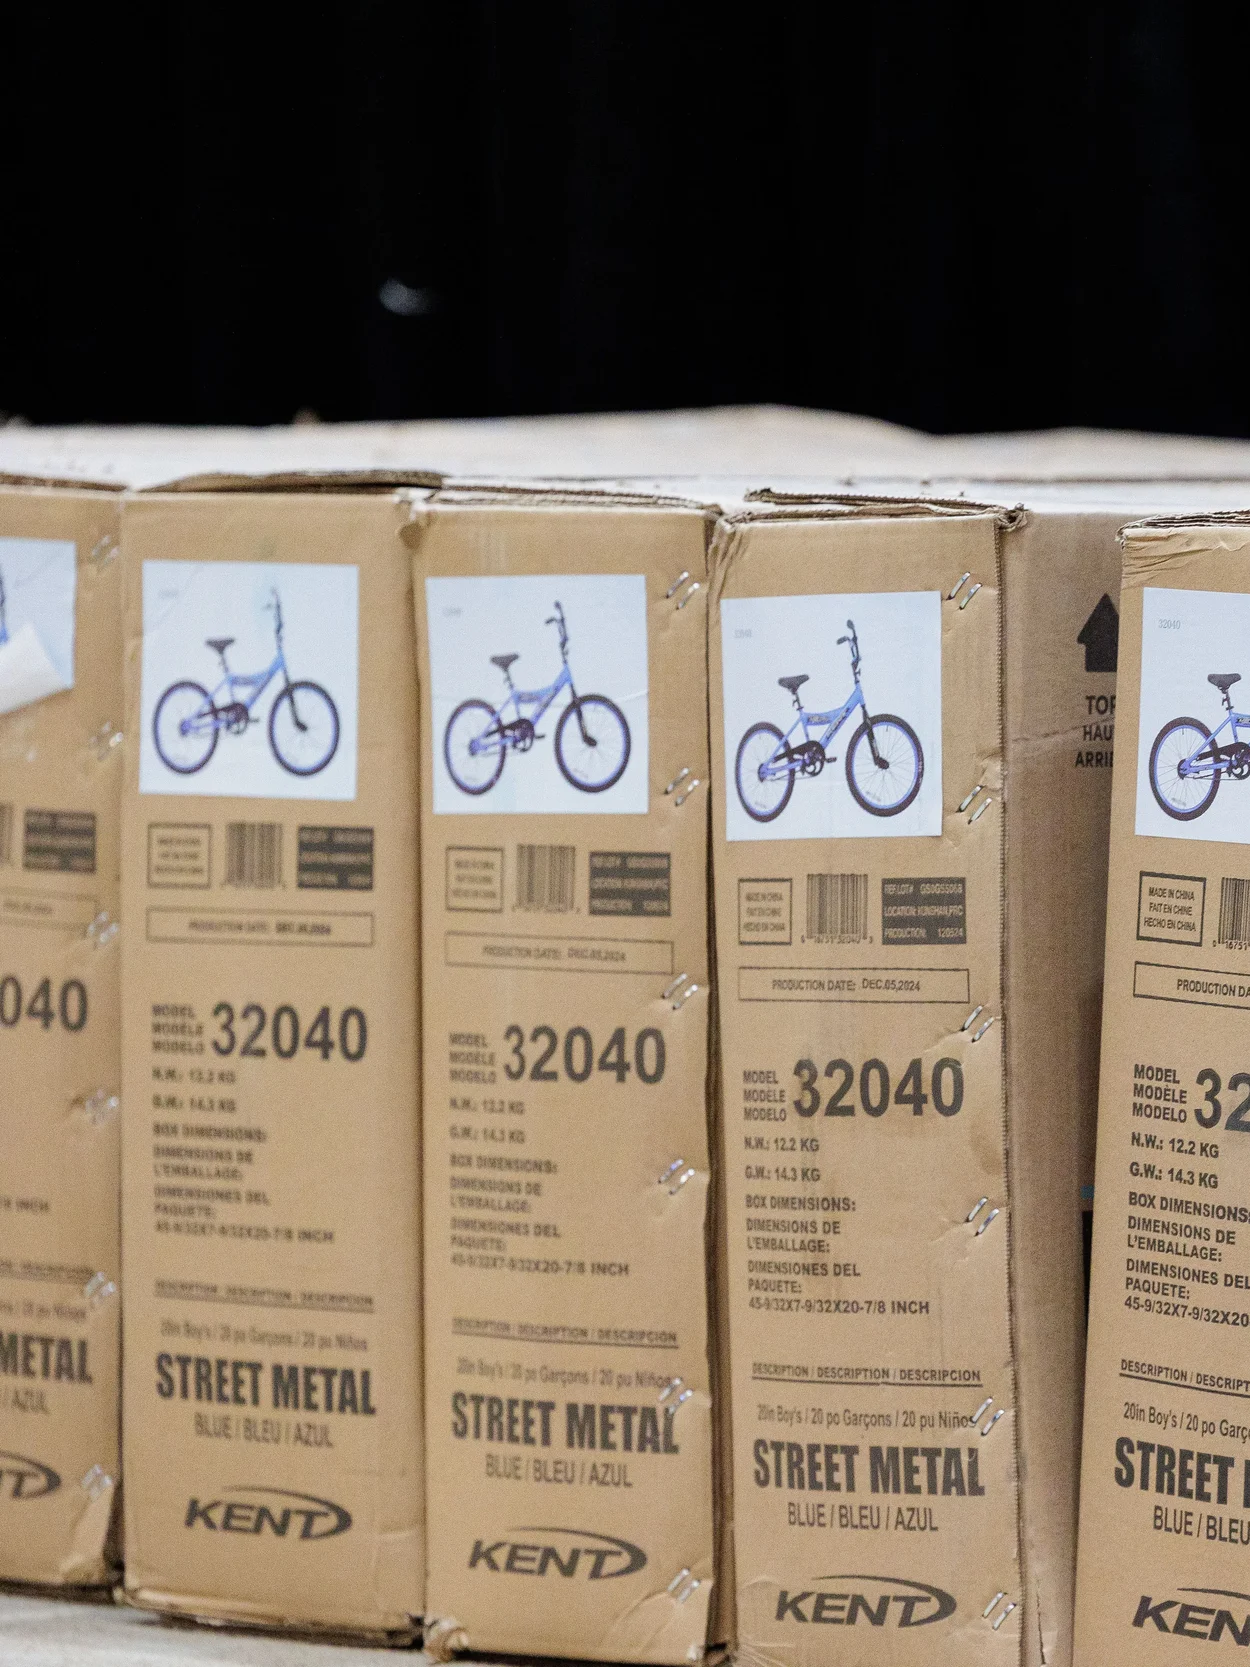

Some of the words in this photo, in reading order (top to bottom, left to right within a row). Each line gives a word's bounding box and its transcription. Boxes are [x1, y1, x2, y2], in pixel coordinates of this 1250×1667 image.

[1158, 618, 1181, 630] 32040
[1082, 725, 1115, 741] HAU
[1149, 887, 1167, 898] MADE
[1168, 889, 1174, 899] IN
[1175, 890, 1195, 901] CHINA
[1149, 902, 1164, 913] FAIT
[1164, 903, 1173, 914] EN
[1174, 905, 1192, 916] CHINE
[1144, 917, 1166, 928] HECHO
[1168, 919, 1176, 930] EN
[1177, 920, 1196, 932] CHINA
[772, 979, 825, 991] PRODUCTION
[1177, 978, 1236, 997] PRODUCTION
[212, 1001, 368, 1063] 32040
[504, 1024, 666, 1084] 32040
[743, 1070, 779, 1085] MODEL
[793, 1057, 964, 1118] 32040
[1134, 1064, 1180, 1084] MODEL
[1133, 1084, 1187, 1104] MODÈLE
[1132, 1102, 1187, 1123] MODELO
[1131, 1132, 1163, 1150] N.W.:
[1169, 1138, 1196, 1155] 12.2
[1200, 1143, 1219, 1158] KG
[1130, 1162, 1162, 1180] G.W.:
[1168, 1168, 1194, 1185] 14.3
[1199, 1173, 1218, 1189] KG
[1129, 1191, 1156, 1209] BOX
[1128, 1216, 1210, 1241] DIMENSIONS
[1216, 1230, 1236, 1245] DE
[1128, 1234, 1222, 1262] L'EMBALLAGE:
[1126, 1258, 1218, 1285] DIMENSIONES
[1126, 1278, 1190, 1300] PAQUETE:
[891, 1301, 929, 1314] INCH
[0, 1330, 93, 1385] METAL
[1121, 1359, 1187, 1382] DESCRIPTION
[156, 1351, 263, 1407] STREET
[272, 1363, 376, 1417] METAL
[452, 1391, 555, 1447] STREET
[566, 1402, 680, 1454] METAL
[1123, 1402, 1146, 1422] 20in
[1149, 1407, 1177, 1430] Boy's
[1186, 1413, 1199, 1432] 20
[1202, 1418, 1215, 1437] po
[486, 1453, 522, 1480] BLUE
[534, 1459, 575, 1485] BLEU
[588, 1462, 633, 1488] AZUL
[753, 1438, 859, 1493] STREET
[869, 1445, 985, 1497] METAL
[1114, 1436, 1235, 1505] STREET
[184, 1497, 329, 1541] KENT
[788, 1502, 826, 1528] BLUE
[839, 1505, 881, 1531] BLEU
[895, 1507, 939, 1532] AZUL
[1153, 1505, 1193, 1537] BLUE
[1206, 1515, 1250, 1545] BLEU
[468, 1539, 622, 1580] KENT
[775, 1590, 931, 1629] KENT
